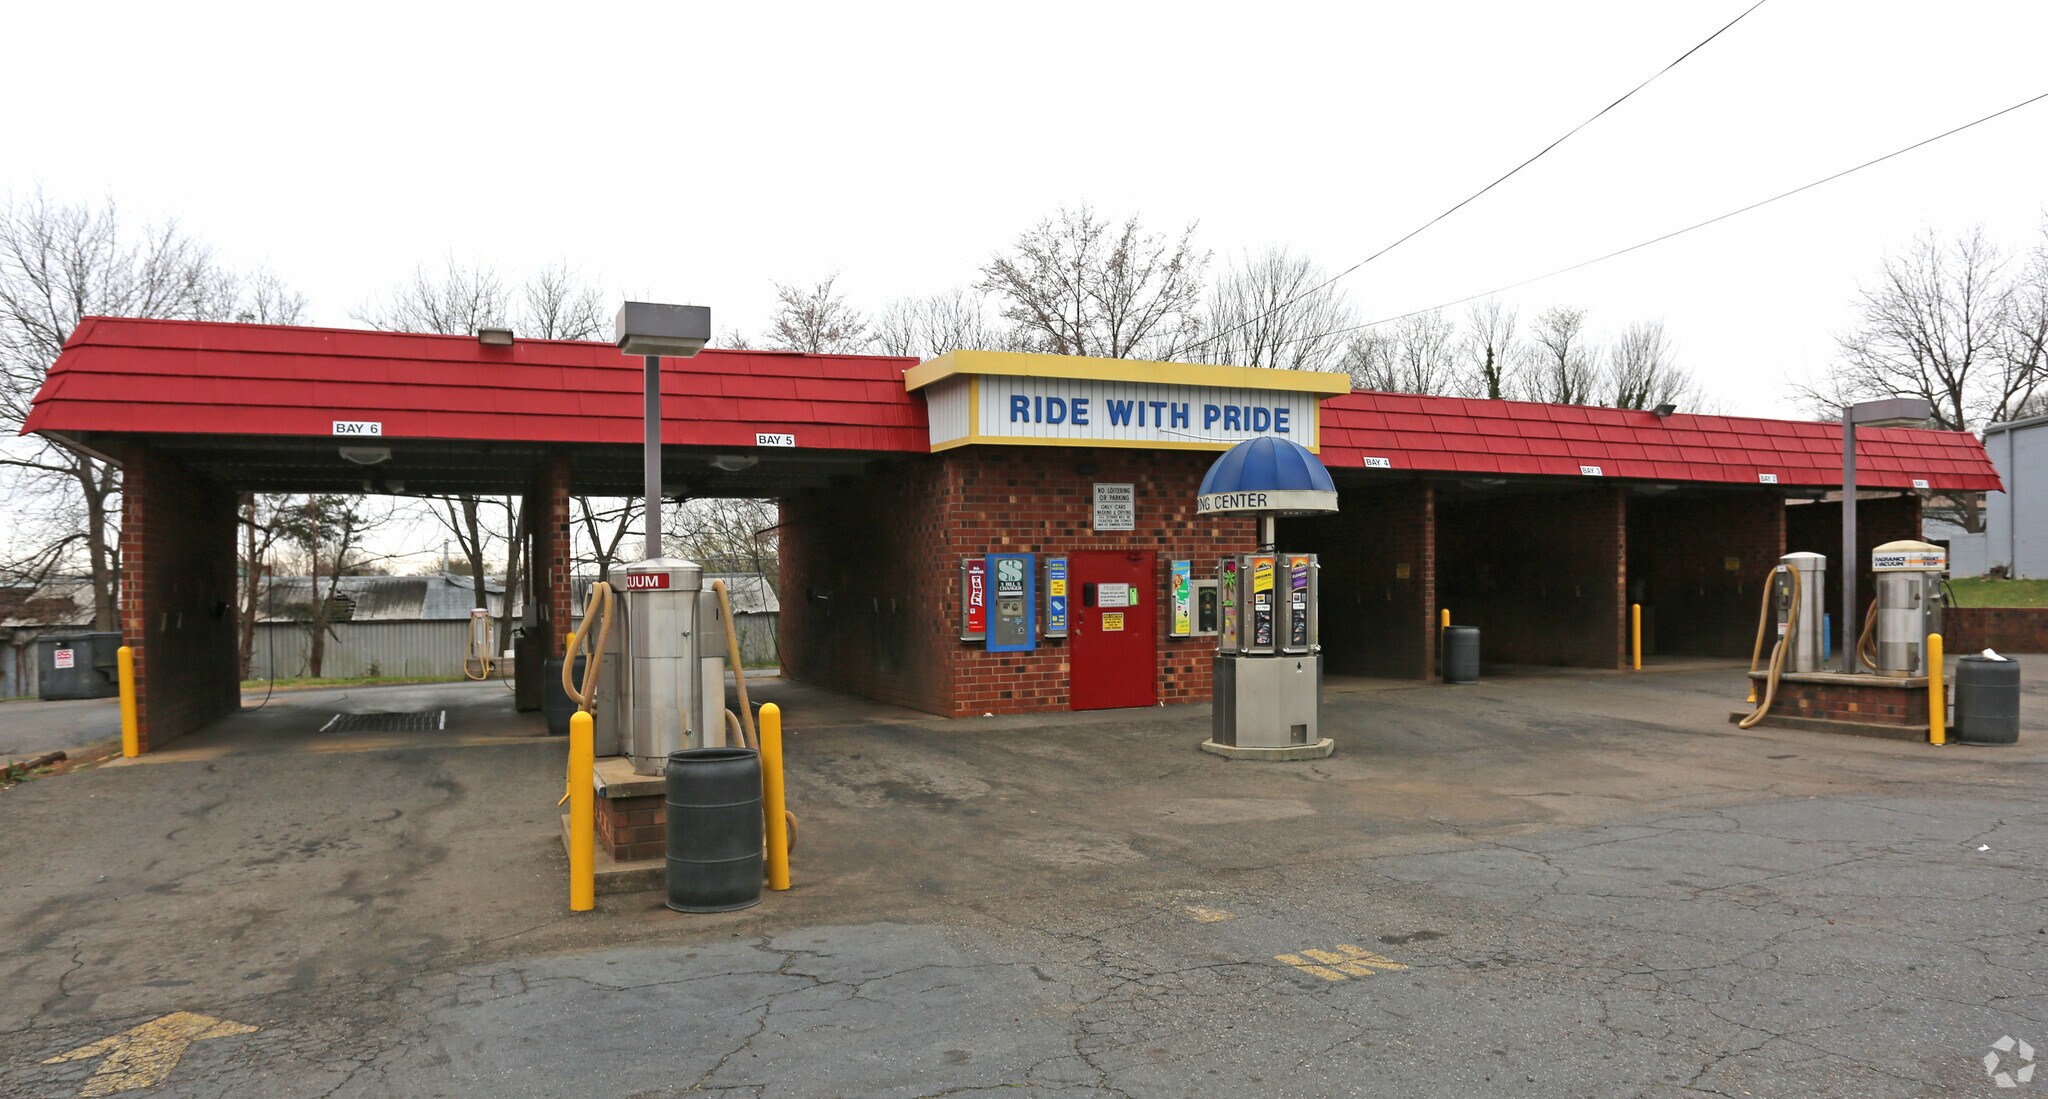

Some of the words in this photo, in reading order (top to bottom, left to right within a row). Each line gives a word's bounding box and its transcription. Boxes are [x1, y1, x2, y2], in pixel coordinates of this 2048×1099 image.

[1011, 395, 1089, 425] RIDE
[1107, 400, 1189, 429] WITH
[1204, 404, 1290, 433] PRIDE
[336, 423, 364, 433] BAY
[370, 424, 378, 434] 6
[758, 435, 781, 445] BAY
[786, 436, 793, 446] 5
[1366, 458, 1380, 466] BAY
[1384, 459, 1389, 467] 4
[1214, 493, 1267, 509] CENTER
[973, 576, 981, 604] TOWEL
